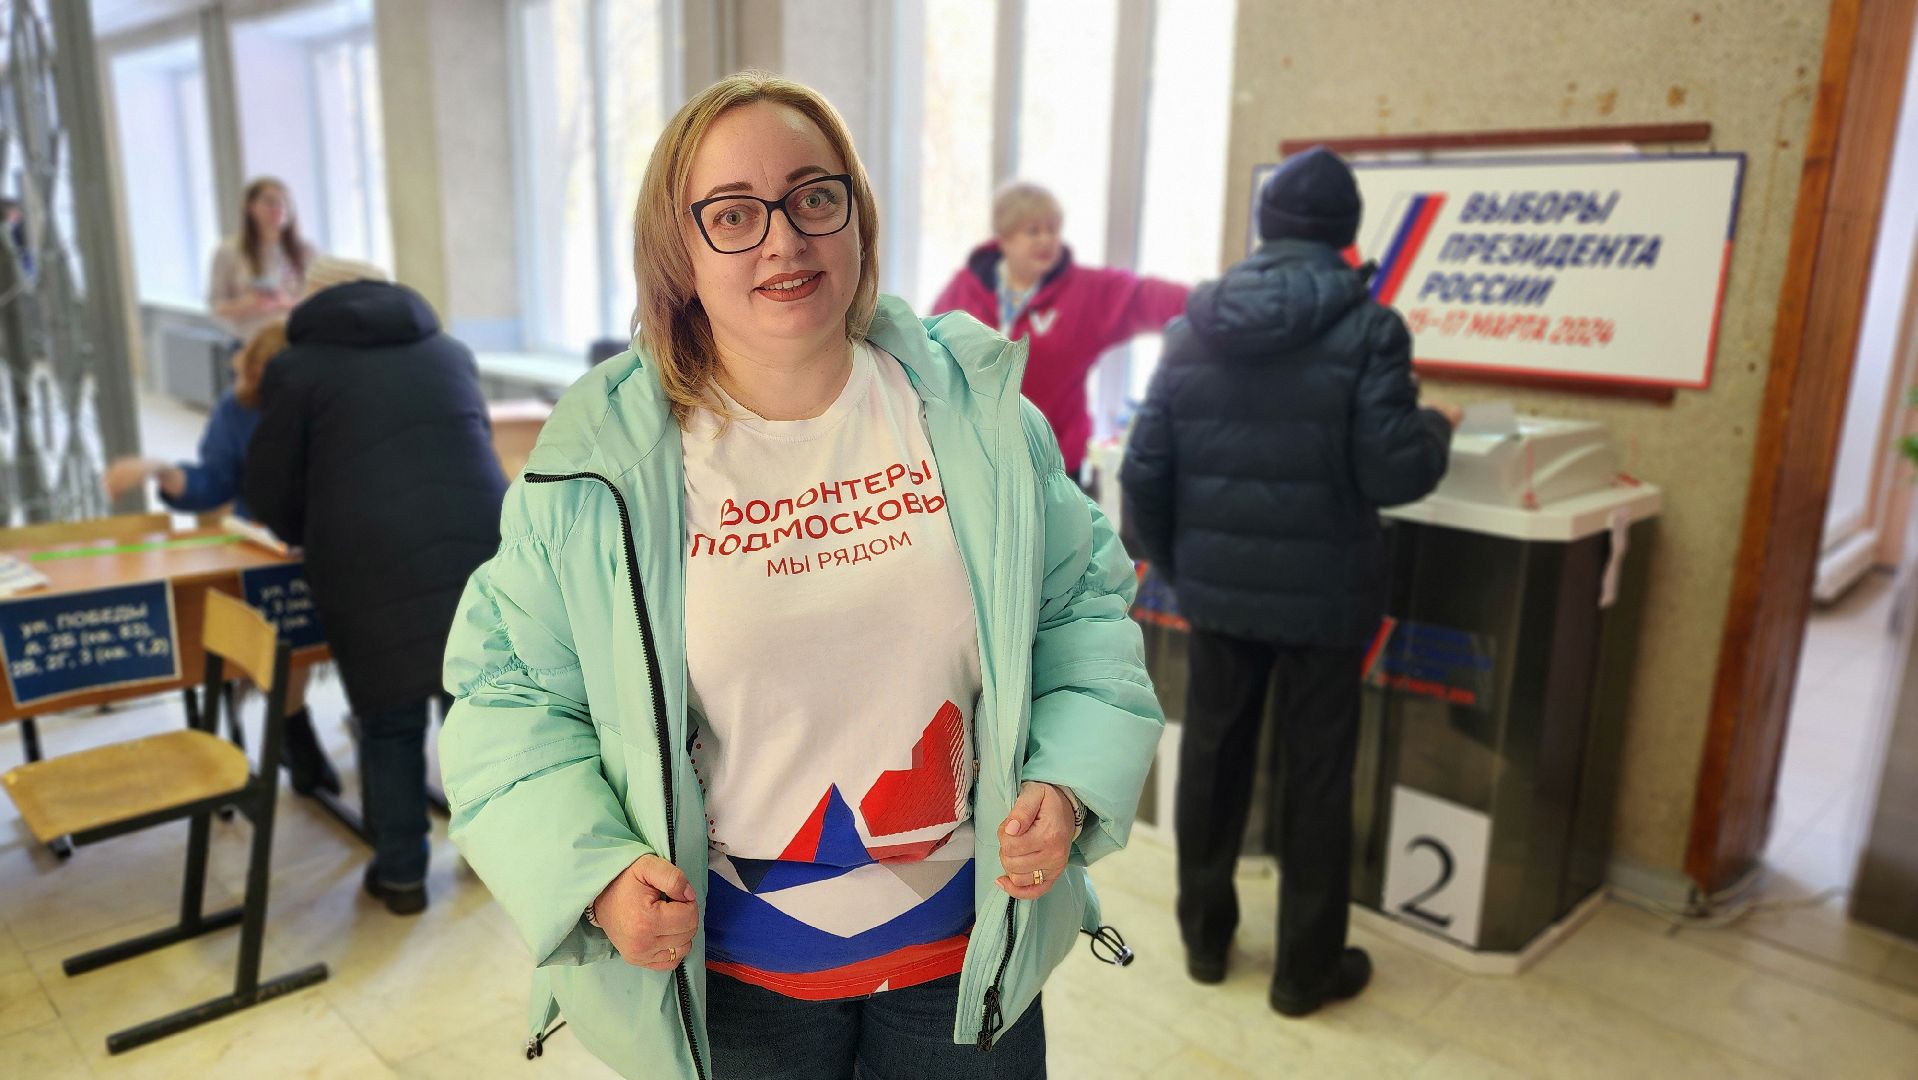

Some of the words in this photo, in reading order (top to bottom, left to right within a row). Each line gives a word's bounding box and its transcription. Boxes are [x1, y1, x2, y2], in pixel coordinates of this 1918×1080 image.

[1459, 190, 1620, 224] ВЫБОРЫ
[1439, 233, 1663, 269] ПРЕЗИДЕНТА
[1418, 272, 1555, 307] РОССИИ
[1465, 312, 1550, 341] МАРТА
[1550, 315, 1615, 347] 2024
[719, 459, 933, 530] ВОЛОНТЕРЫ
[690, 492, 945, 557] ПОДМОСКОВЬ
[767, 554, 810, 577] МЫ
[817, 531, 913, 570] РЯДОМ
[56, 602, 148, 630] ПОБЕДЫ
[1399, 834, 1455, 928] 2
